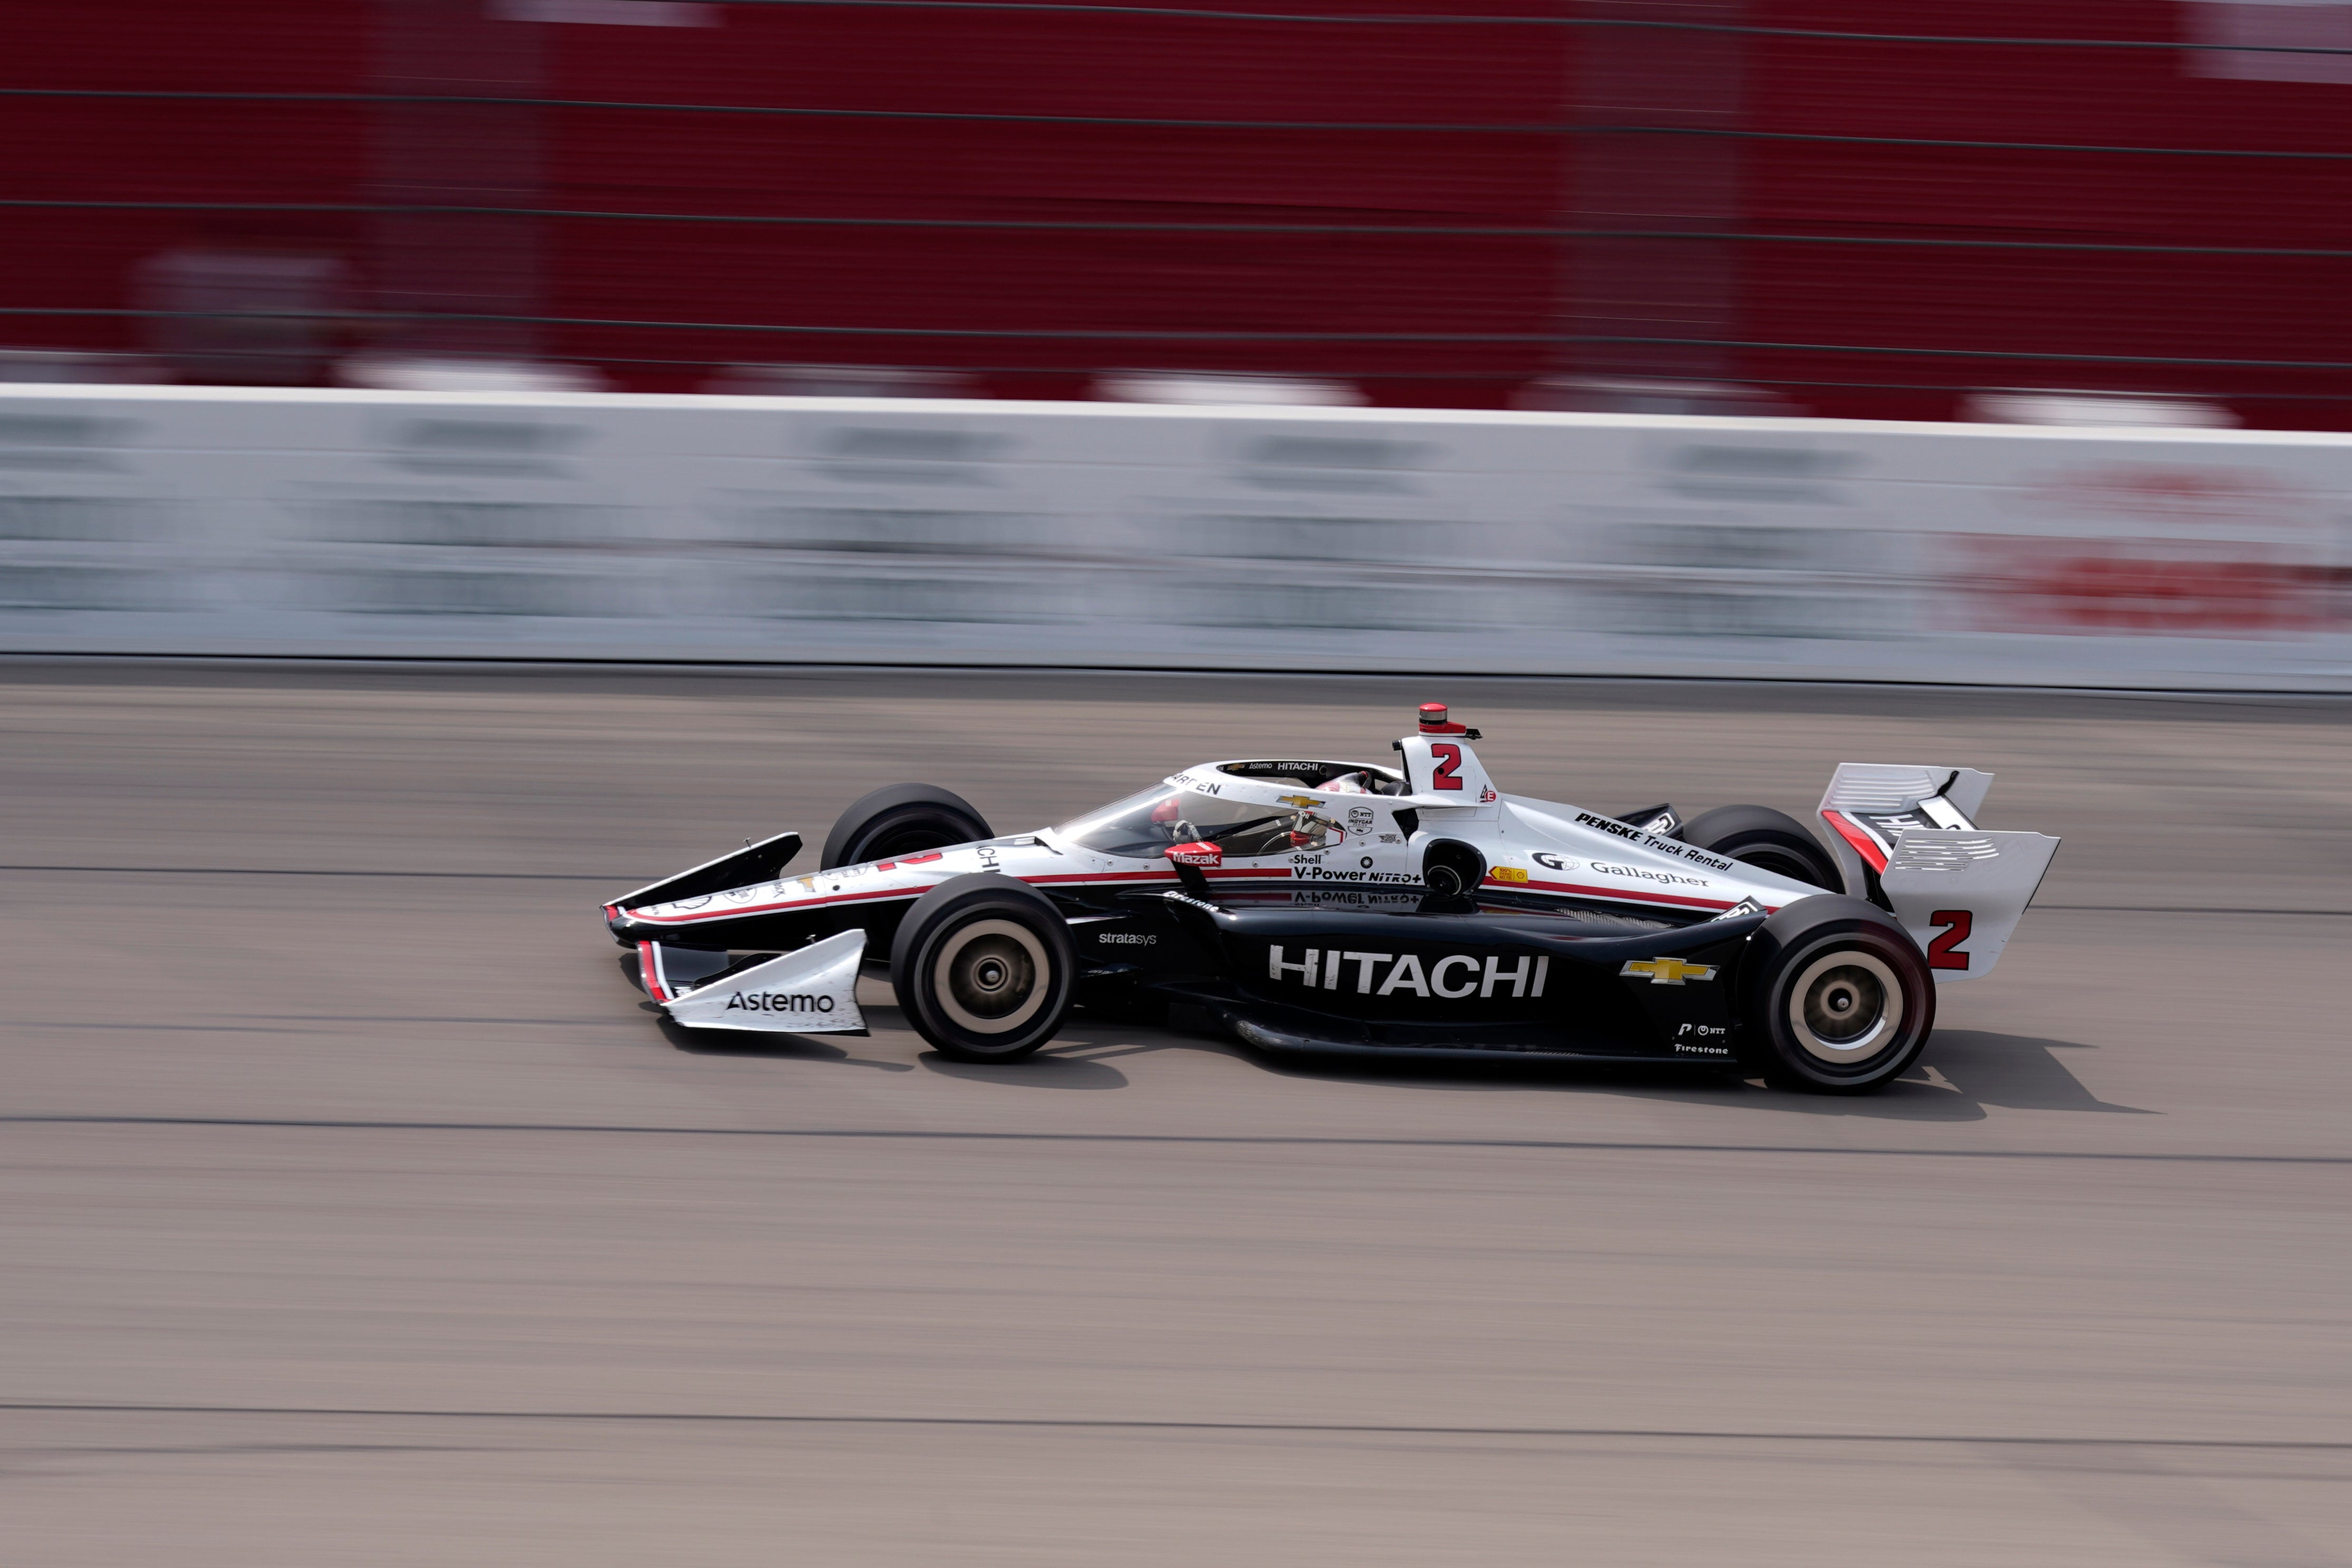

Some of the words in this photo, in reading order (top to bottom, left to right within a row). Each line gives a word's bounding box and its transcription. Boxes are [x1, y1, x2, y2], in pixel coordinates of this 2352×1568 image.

[1277, 762, 1318, 771] HITACHI
[1431, 743, 1463, 790] 2
[1575, 812, 1643, 842] PENSKE
[1643, 835, 1685, 856] Truck
[1685, 849, 1734, 872] Rental
[1172, 851, 1219, 864] Mazak
[1294, 854, 1321, 865] Shell
[1294, 866, 1367, 881] V-Power
[1591, 862, 1710, 887] Gallagher
[1098, 932, 1157, 947] stratasys
[1927, 909, 1973, 971] 2
[1269, 944, 1549, 999] HITACHI
[726, 991, 834, 1013] Astemo
[1674, 1043, 1729, 1054] Firestone
